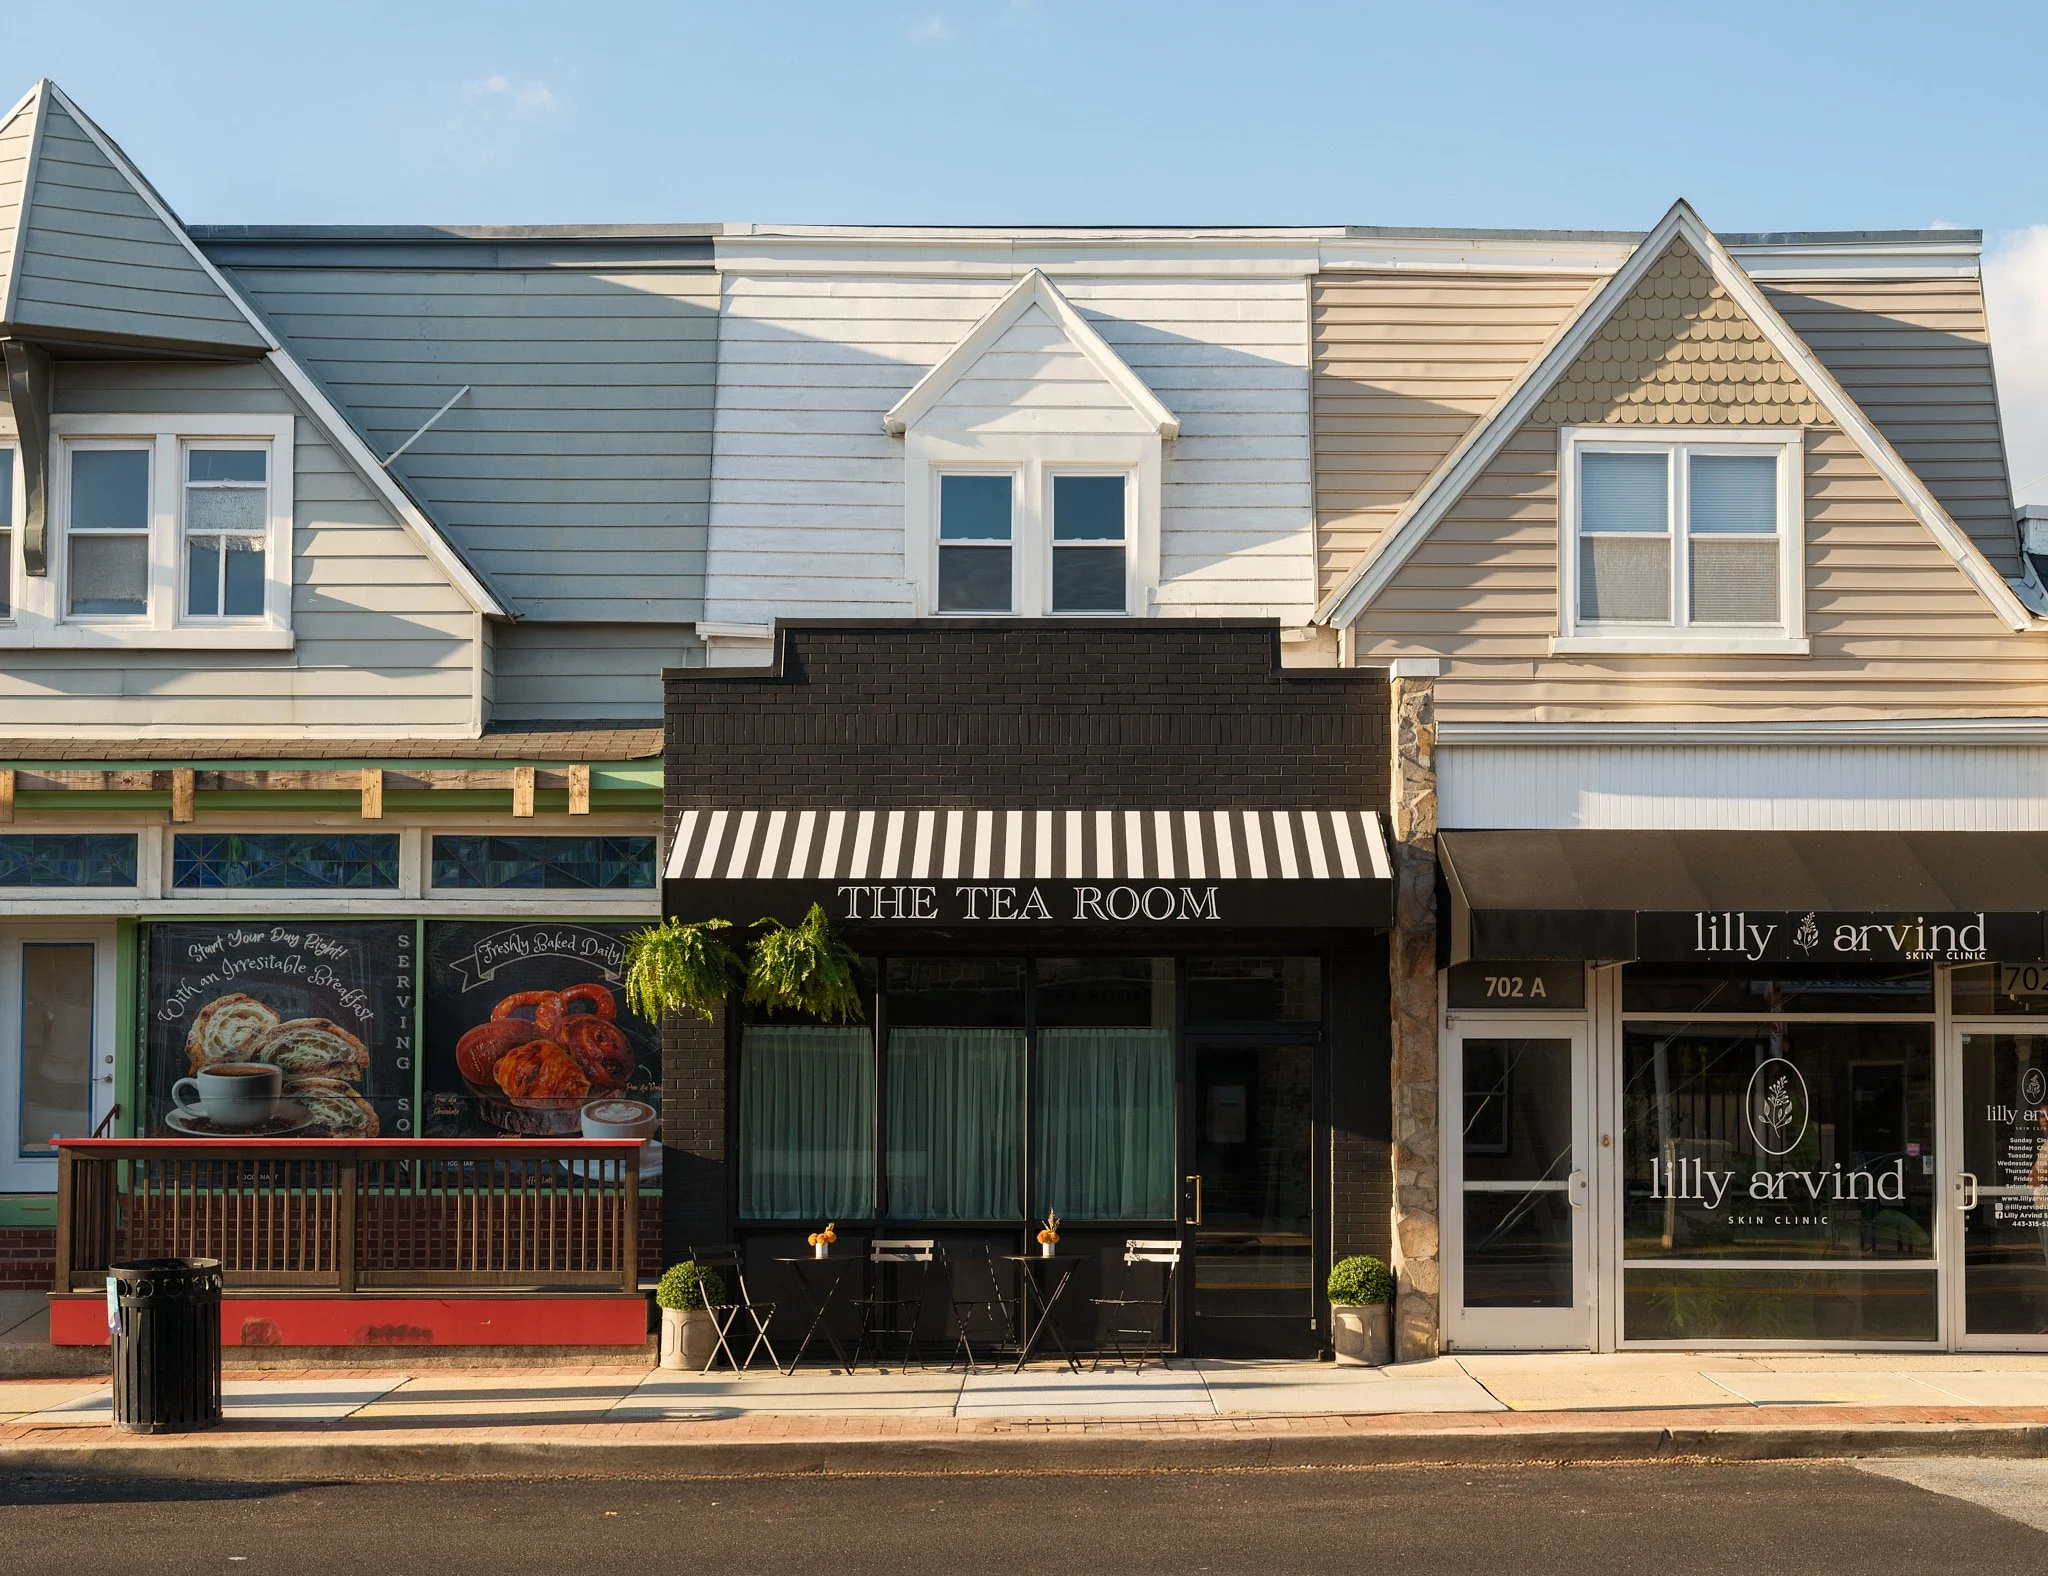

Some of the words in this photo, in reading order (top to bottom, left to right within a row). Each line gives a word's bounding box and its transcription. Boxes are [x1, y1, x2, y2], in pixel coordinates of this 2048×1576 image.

[838, 886, 939, 919] THE
[956, 886, 1054, 920] TEA
[1072, 886, 1221, 920] ROOM
[188, 935, 224, 962] Start
[228, 929, 265, 947] Your
[270, 927, 300, 947] Day
[304, 933, 348, 960] Right!
[479, 933, 529, 964] Freshly
[533, 932, 576, 953] Baked
[580, 938, 620, 966] Daily
[1694, 912, 1778, 961] lilly
[1833, 912, 1988, 952] arvind
[1905, 951, 1934, 960] SKIN
[1946, 951, 1987, 960] CLINIC
[157, 977, 202, 1022] With
[201, 973, 220, 987] an
[308, 964, 375, 1022] Breakfast
[396, 934, 411, 1070] SERVING
[1484, 976, 1524, 998] 702
[1530, 977, 1547, 998] A
[1986, 1104, 2019, 1125] lilly
[2008, 1152, 2033, 1160] Tuesday
[1649, 1157, 1736, 1210] lilly
[1749, 1159, 1906, 1201] arvind
[1728, 1216, 1763, 1225] SKIN
[1774, 1216, 1828, 1225] CLINIC
